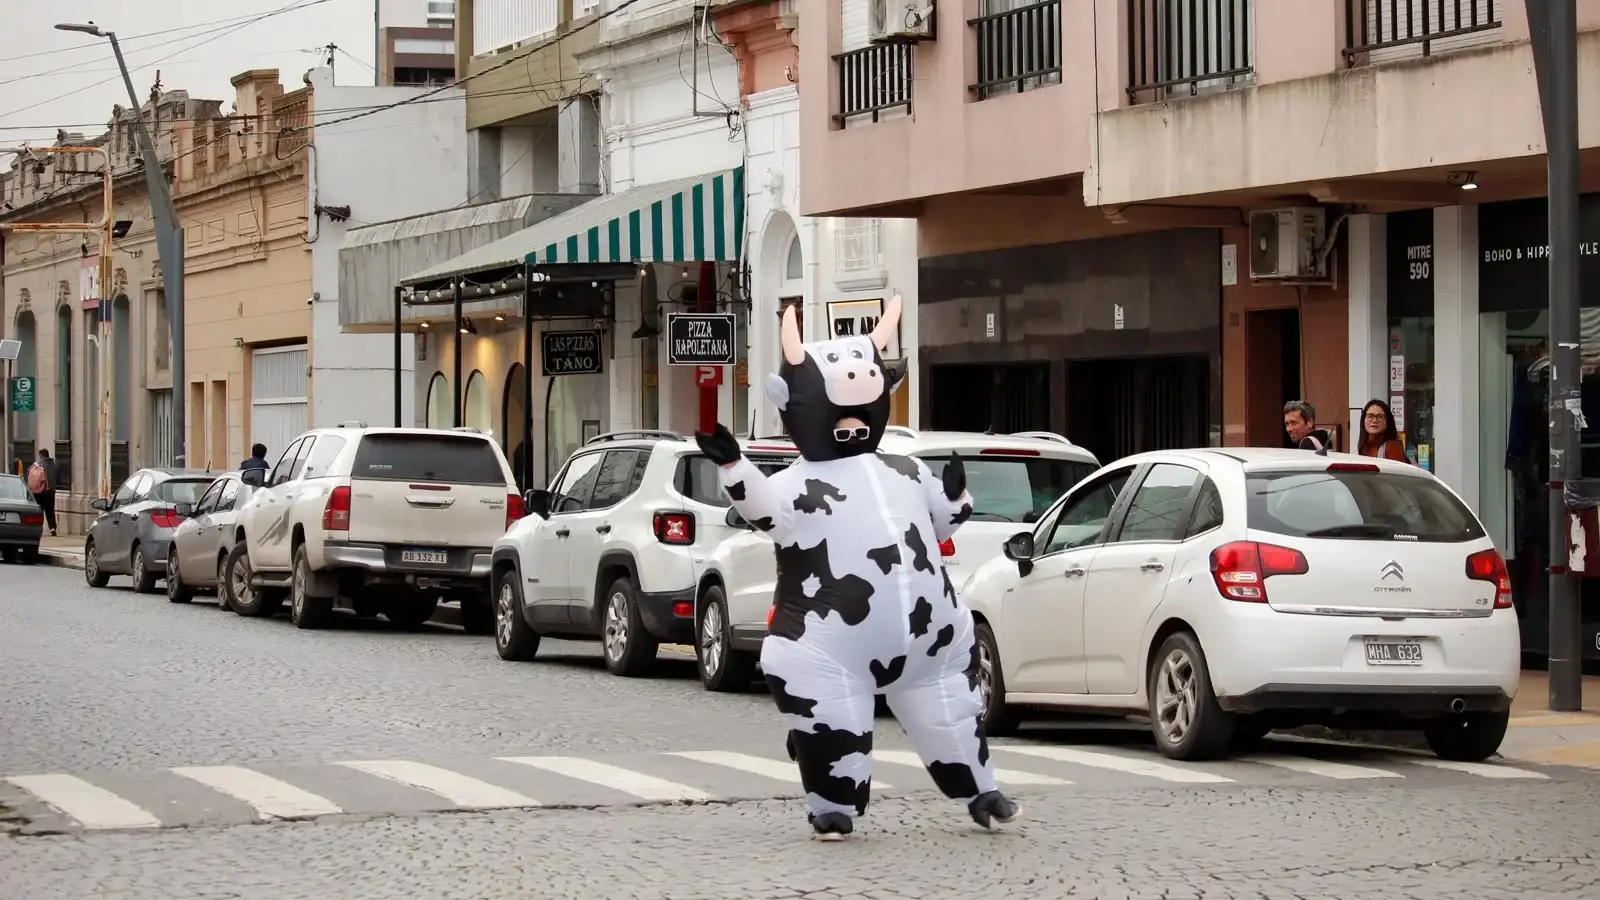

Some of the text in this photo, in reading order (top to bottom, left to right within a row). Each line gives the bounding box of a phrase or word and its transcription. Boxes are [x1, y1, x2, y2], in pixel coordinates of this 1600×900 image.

[1407, 245, 1431, 260] MITRE
[1485, 242, 1598, 262] BOHO & HIPP YLE
[1410, 262, 1429, 280] 590
[688, 321, 713, 337] PIZZA
[551, 337, 566, 352] LAS
[675, 339, 728, 355] NAPOLETANA
[552, 356, 593, 370] TANO
[404, 551, 415, 561] AB
[417, 552, 433, 562] 132
[1368, 644, 1422, 661] MHA 632
